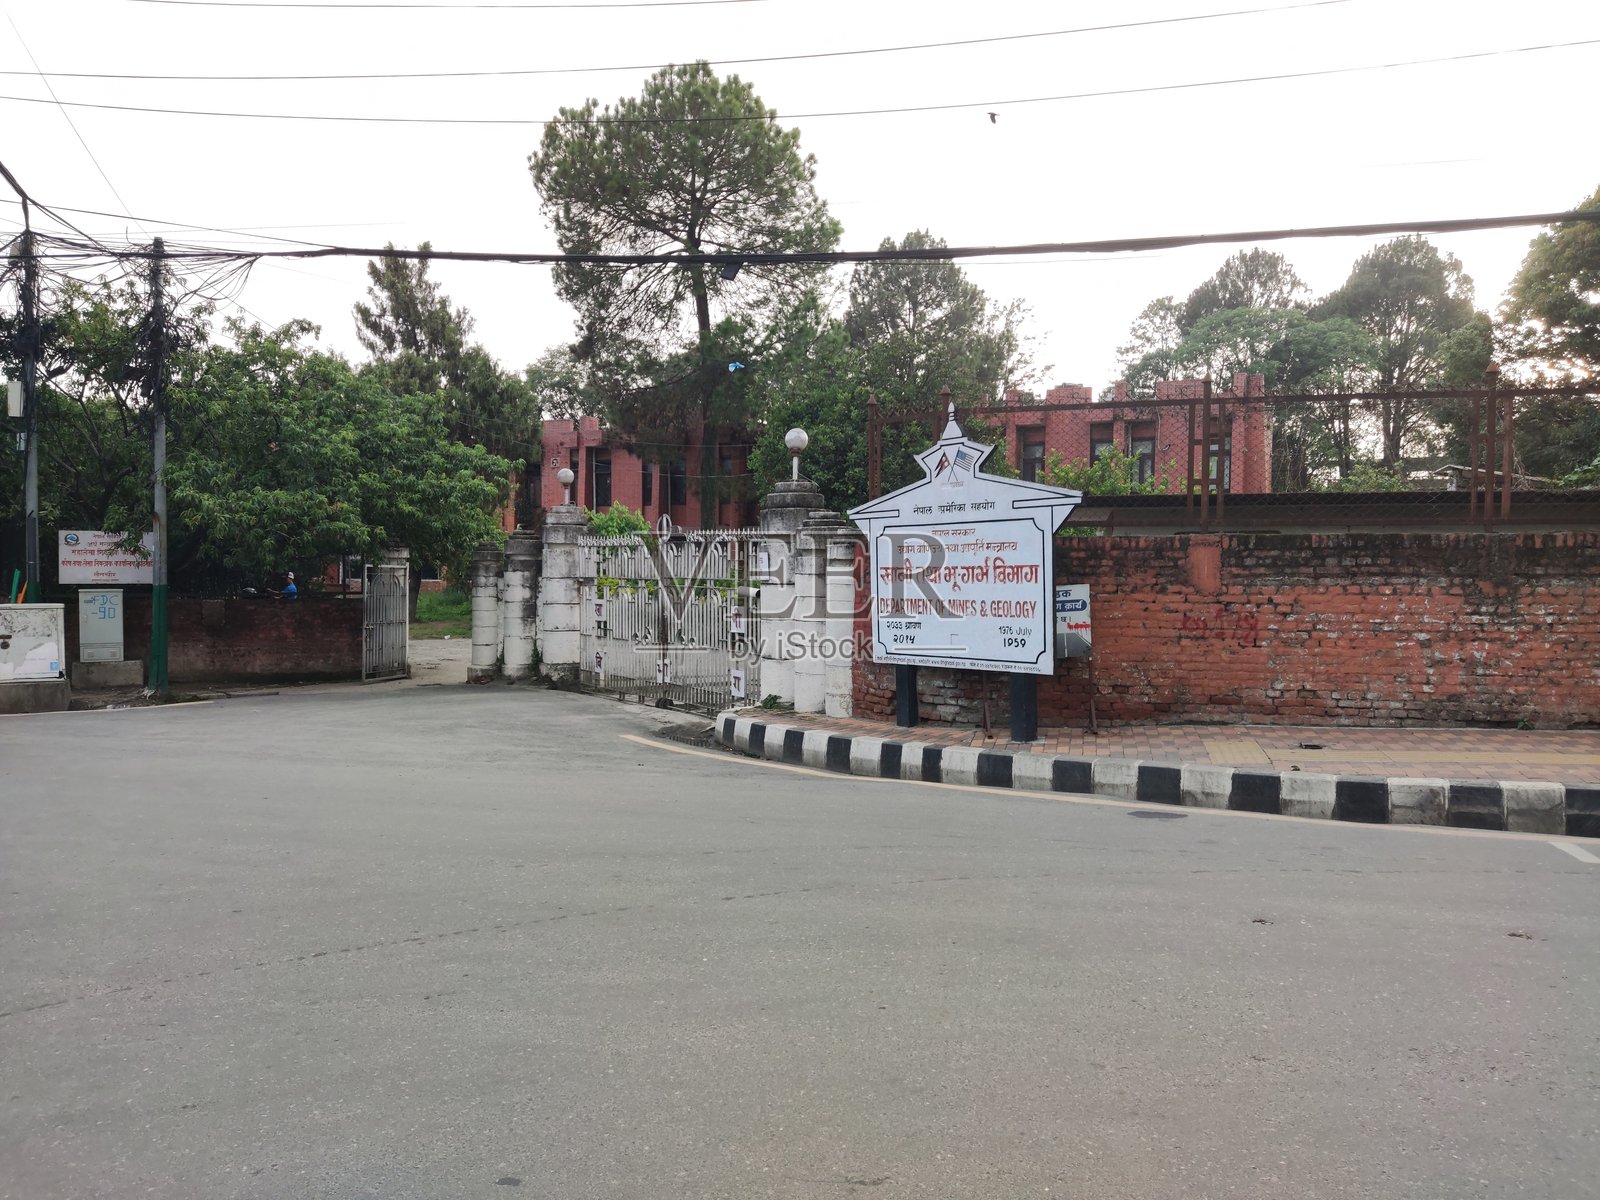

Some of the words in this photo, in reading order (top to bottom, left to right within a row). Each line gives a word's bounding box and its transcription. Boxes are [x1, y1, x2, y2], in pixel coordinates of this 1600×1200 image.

[913, 503, 932, 514] नेपाल
[970, 499, 995, 511] सहयोग
[986, 541, 1018, 553] मन्त्रालय
[992, 556, 1039, 585] विभाग
[879, 598, 932, 616] DEPARTMENT
[935, 599, 945, 616] OF
[949, 598, 977, 617] MINES
[980, 600, 988, 617] &
[990, 599, 1038, 619] GEOLOGY
[1015, 627, 1033, 638] July
[1003, 637, 1027, 648] 1959
